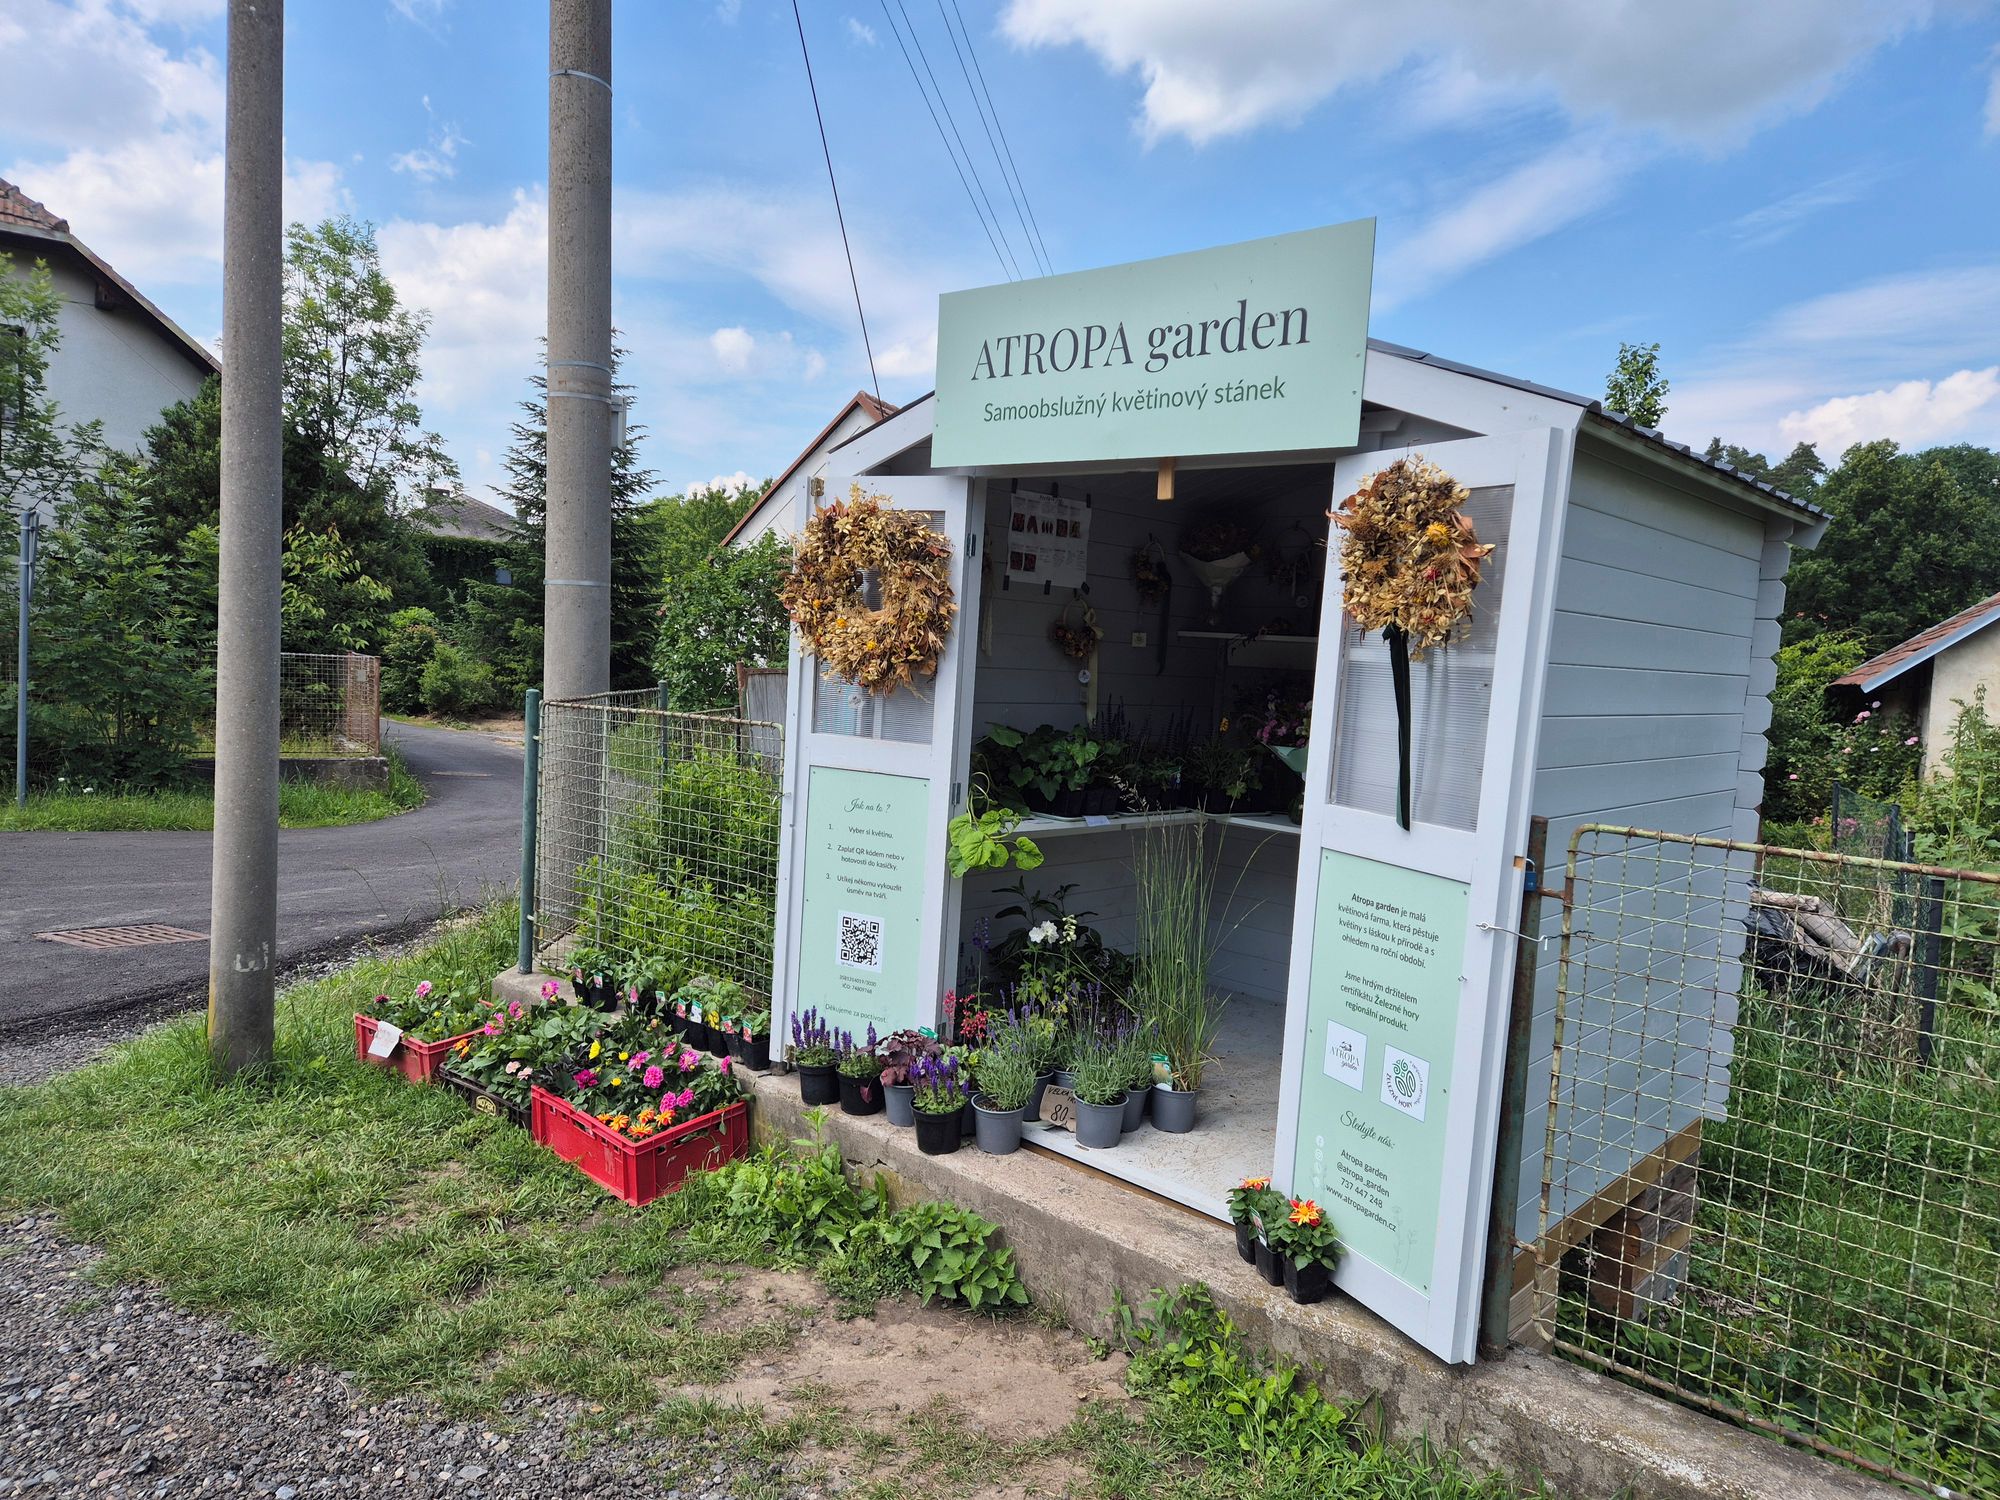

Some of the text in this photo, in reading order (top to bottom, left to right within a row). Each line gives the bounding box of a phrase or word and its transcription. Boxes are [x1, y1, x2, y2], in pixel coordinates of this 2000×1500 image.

[970, 298, 1310, 381] ATROPA garden
[984, 375, 1286, 422] Samoobslužný květinový stánek
[844, 797, 864, 812] Jak
[876, 803, 883, 812] to
[849, 826, 864, 834] Vyber
[841, 855, 867, 865] hotovosti
[856, 847, 865, 855] QR
[866, 849, 885, 858] kódem
[886, 852, 900, 860] nebo
[847, 886, 864, 895] úsměv
[854, 878, 876, 887] někomu
[877, 882, 902, 892] vykouzlit
[1338, 902, 1439, 943] květinová farma, která pěstuje
[1351, 893, 1426, 922] Atropa garden je malá
[1339, 917, 1362, 933] květiny
[1368, 927, 1390, 942] láskou
[1391, 934, 1396, 943] k
[1397, 937, 1423, 952] přírodě
[1342, 933, 1426, 969] ohledem na roční období.
[1340, 984, 1420, 1022] certifikátu Železné hory
[1344, 970, 1418, 1004] Jsme hrdým držitelem
[825, 1003, 852, 1016] Děkujeme
[1345, 1000, 1409, 1032] regionální produkt.
[1329, 1046, 1360, 1066] ATROPA
[1340, 1110, 1396, 1149] Sledujte nás:
[1336, 1161, 1390, 1197] @atropa_garden
[1340, 1149, 1388, 1182] Atropa garden
[1325, 1184, 1397, 1233] www.atropagarden.cz
[1341, 1177, 1383, 1209] 737 447 248
